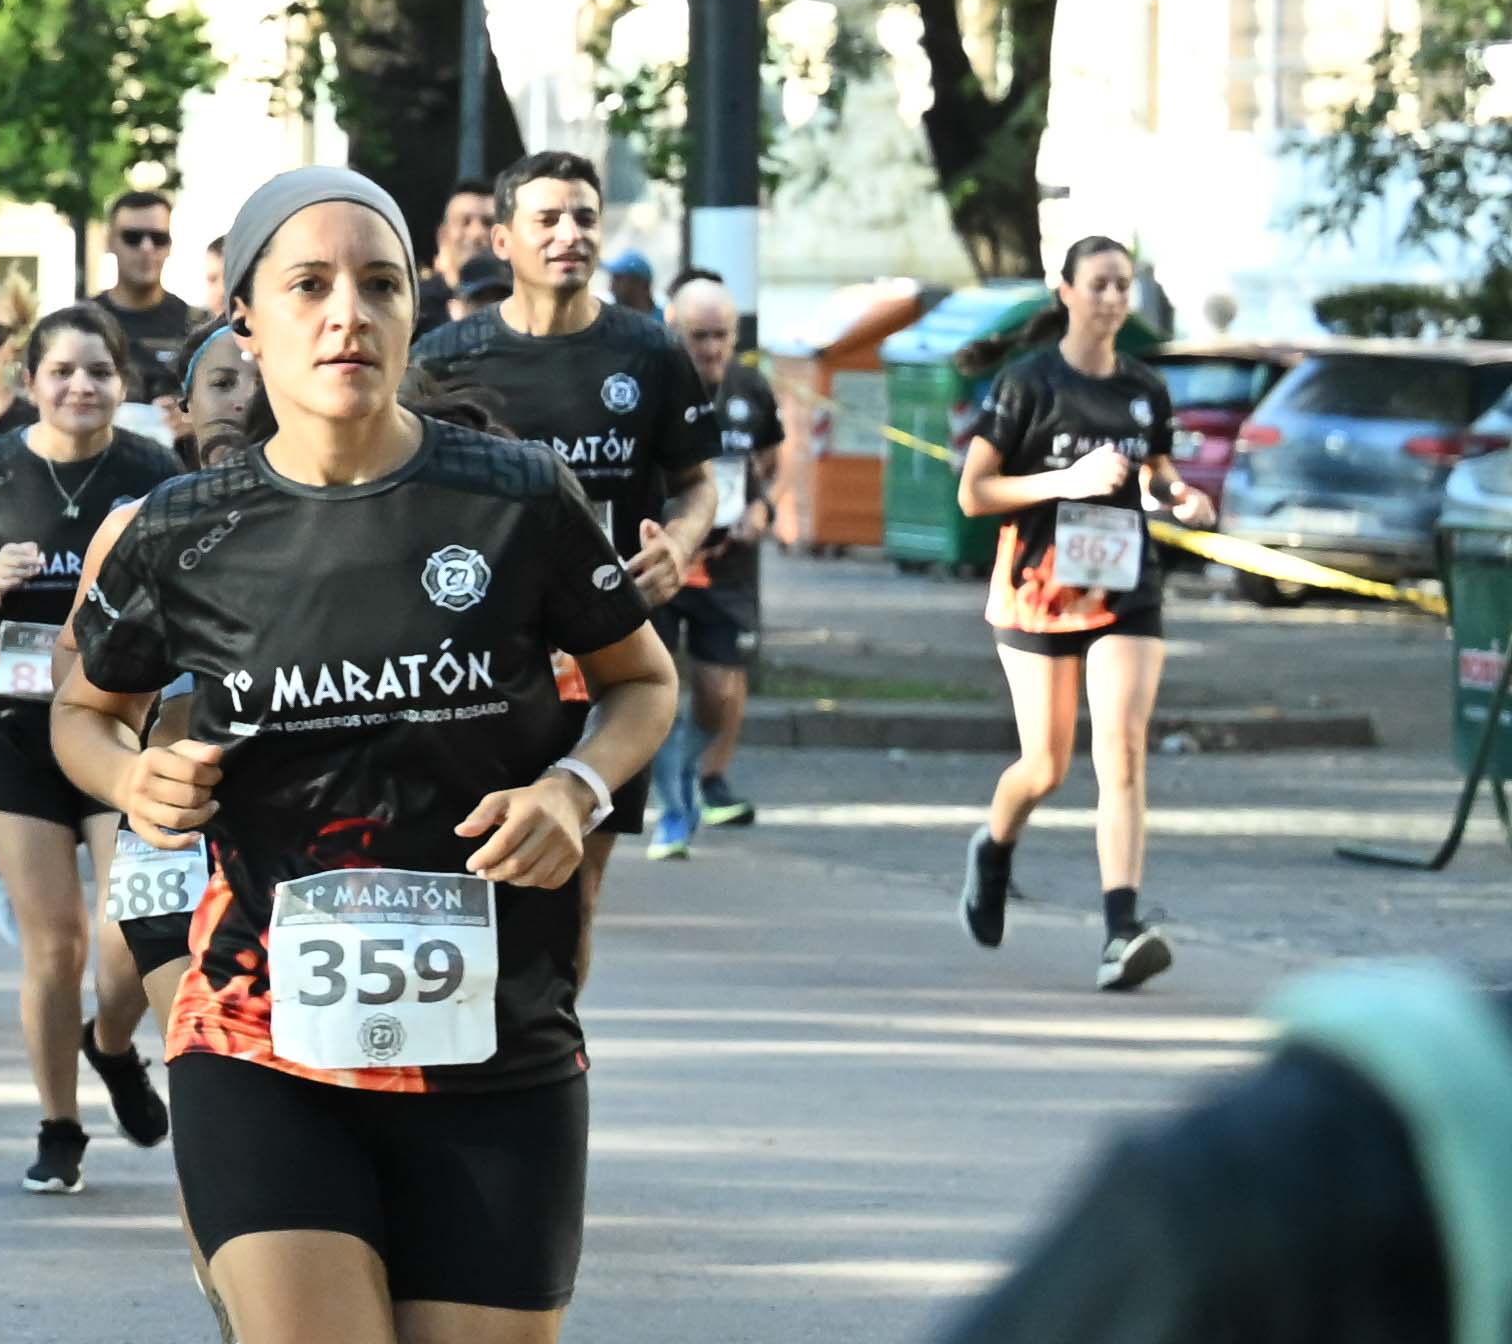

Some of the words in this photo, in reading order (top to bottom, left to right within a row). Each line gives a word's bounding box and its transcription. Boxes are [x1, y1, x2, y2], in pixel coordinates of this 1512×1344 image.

[445, 566, 469, 587] 27
[271, 637, 494, 712] MARATÓN
[285, 713, 361, 733] BOMBEROS
[454, 700, 510, 721] ROSARIO
[333, 880, 463, 911] MARATÓN
[298, 938, 465, 1007] 359
[373, 1028, 392, 1045] 27
